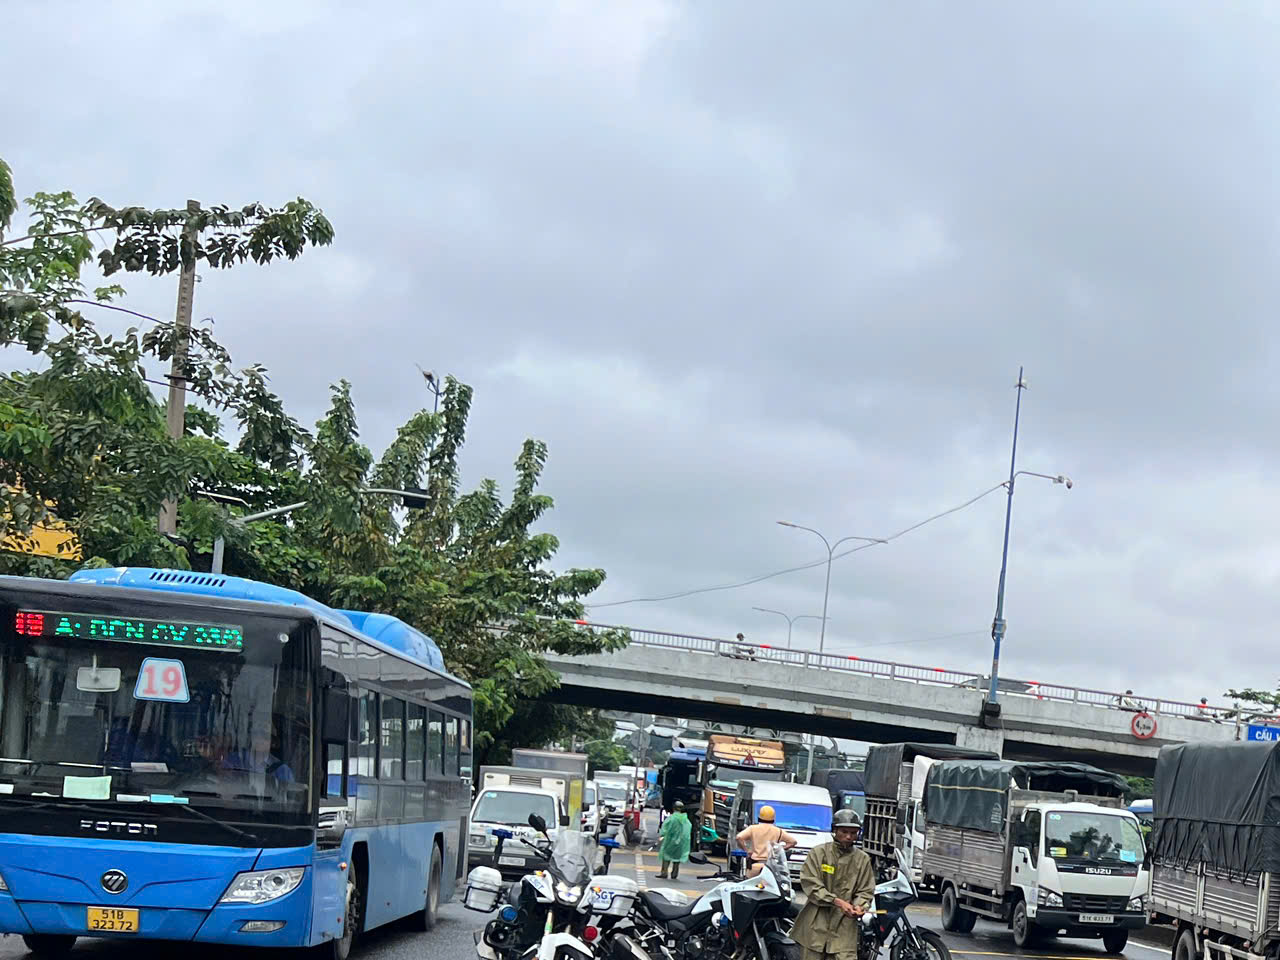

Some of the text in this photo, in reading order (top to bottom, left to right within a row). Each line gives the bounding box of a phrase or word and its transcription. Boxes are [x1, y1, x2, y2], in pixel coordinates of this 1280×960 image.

[143, 666, 182, 696] 19
[80, 820, 158, 835] FOTON
[1085, 867, 1112, 875] ISUZU
[102, 910, 124, 919] 51B
[92, 919, 133, 931] 323.72
